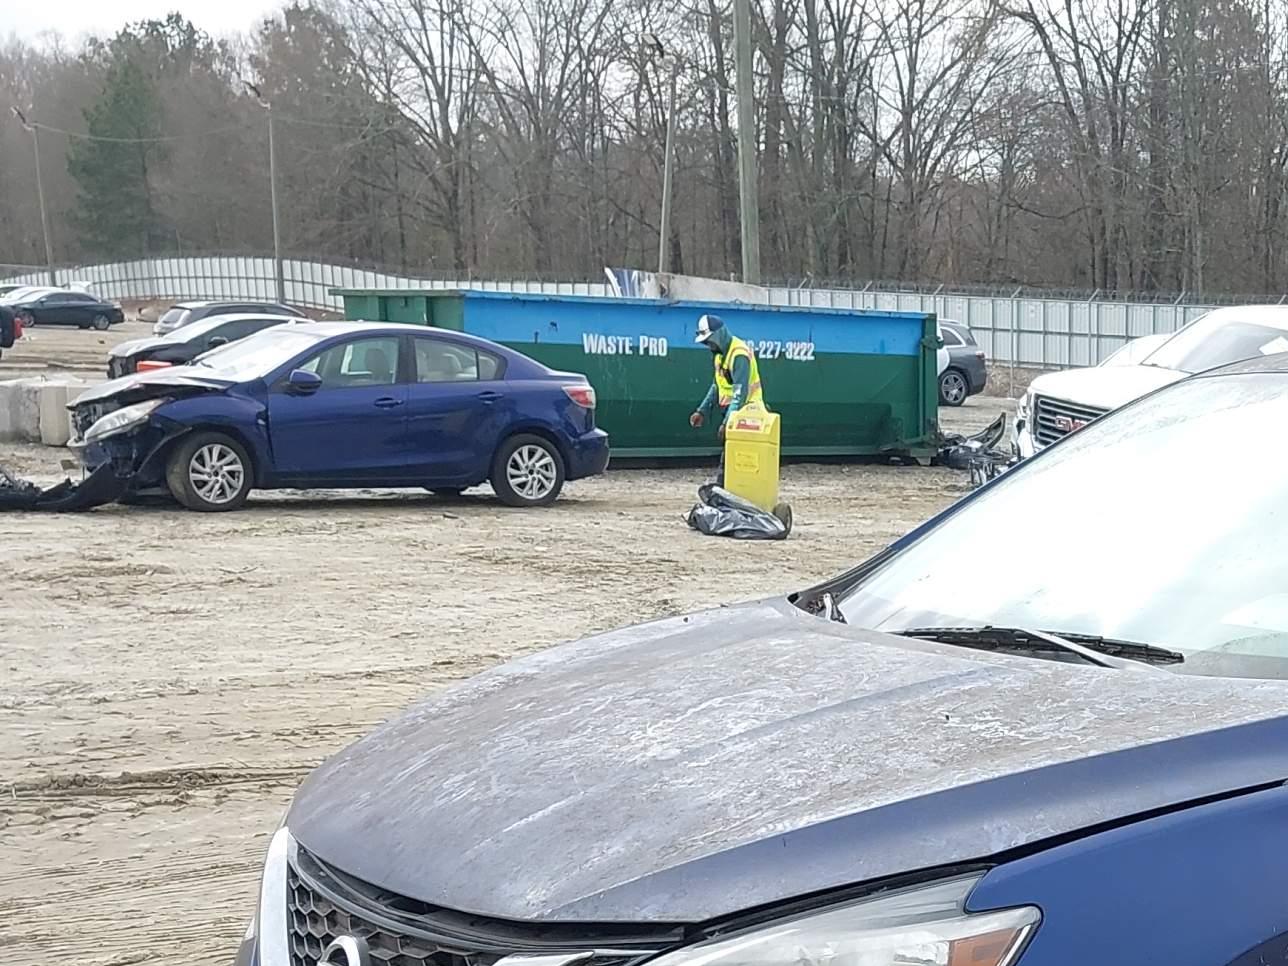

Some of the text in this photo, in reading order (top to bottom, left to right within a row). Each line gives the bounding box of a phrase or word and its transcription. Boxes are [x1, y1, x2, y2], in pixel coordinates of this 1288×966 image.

[583, 333, 632, 355] WASTE
[639, 335, 667, 357] PRO
[1056, 415, 1087, 431] GM
